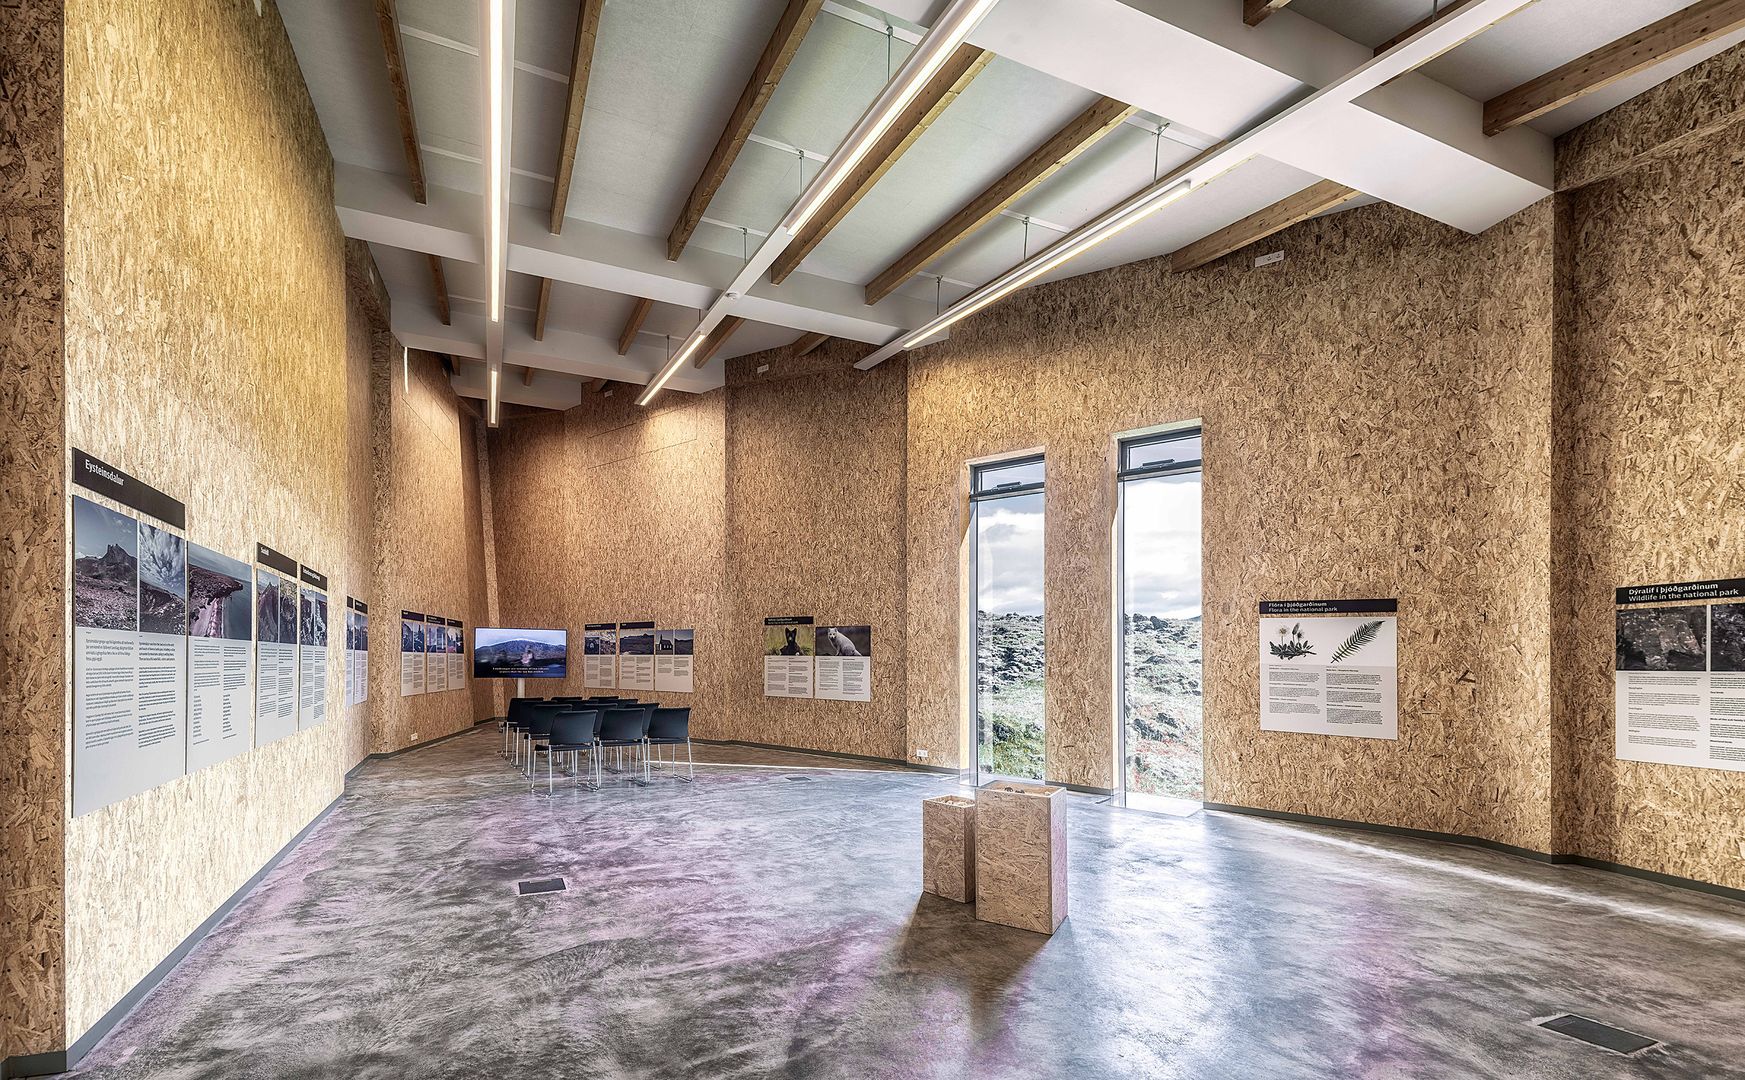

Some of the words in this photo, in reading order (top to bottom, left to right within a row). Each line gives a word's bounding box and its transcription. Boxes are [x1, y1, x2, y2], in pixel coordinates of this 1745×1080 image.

[85, 459, 124, 486] Eysteinsdalur
[1628, 586, 1655, 595] Dýralíf
[1660, 584, 1718, 594] þjóðgarðinum
[1683, 590, 1717, 598] national
[1720, 588, 1739, 597] park
